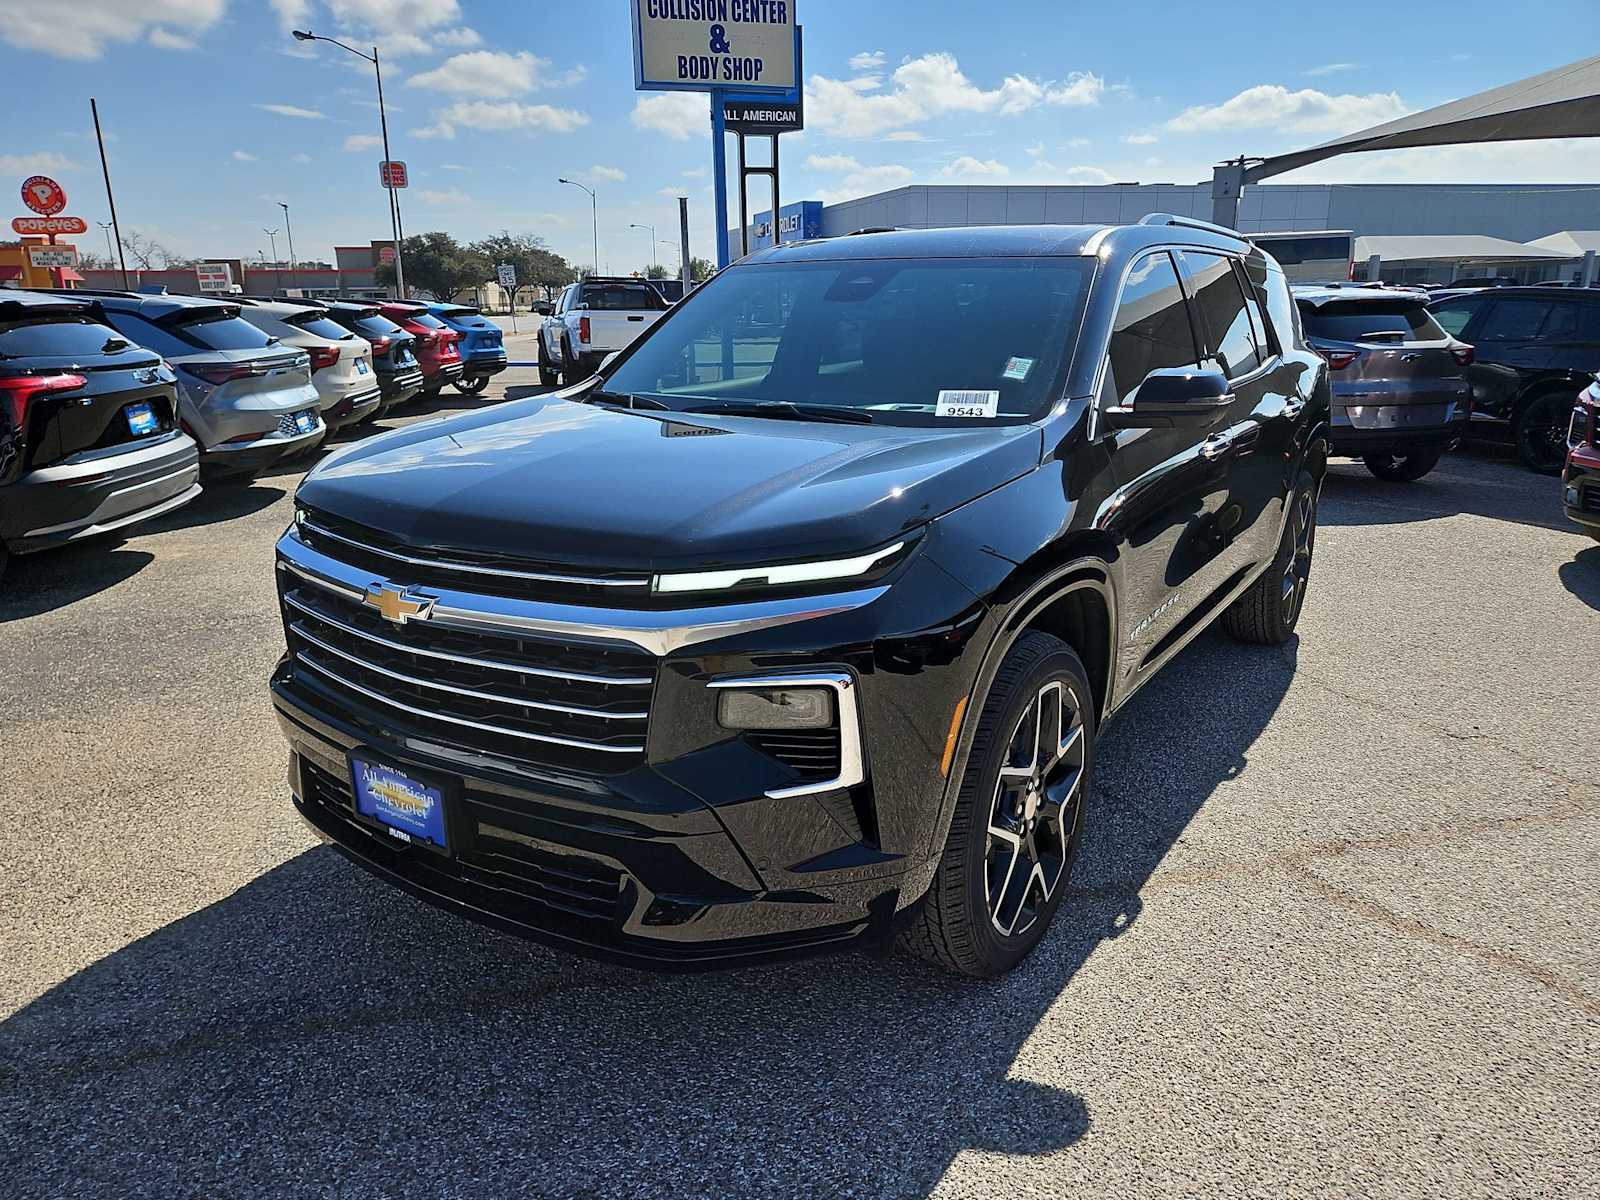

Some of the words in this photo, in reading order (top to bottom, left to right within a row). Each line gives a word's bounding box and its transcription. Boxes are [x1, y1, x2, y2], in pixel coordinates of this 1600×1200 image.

[647, 0, 727, 22] COLLISION
[732, 0, 787, 24] CENTER
[709, 24, 730, 54] &
[677, 55, 719, 80] BODY
[723, 57, 763, 81] SHOP
[742, 110, 797, 122] AMERICAN
[765, 214, 801, 236] CHROLET
[501, 276, 515, 285] 35
[947, 407, 984, 417] 9543
[362, 769, 378, 783] All
[382, 776, 435, 806] American
[373, 788, 428, 819] Chevrolet
